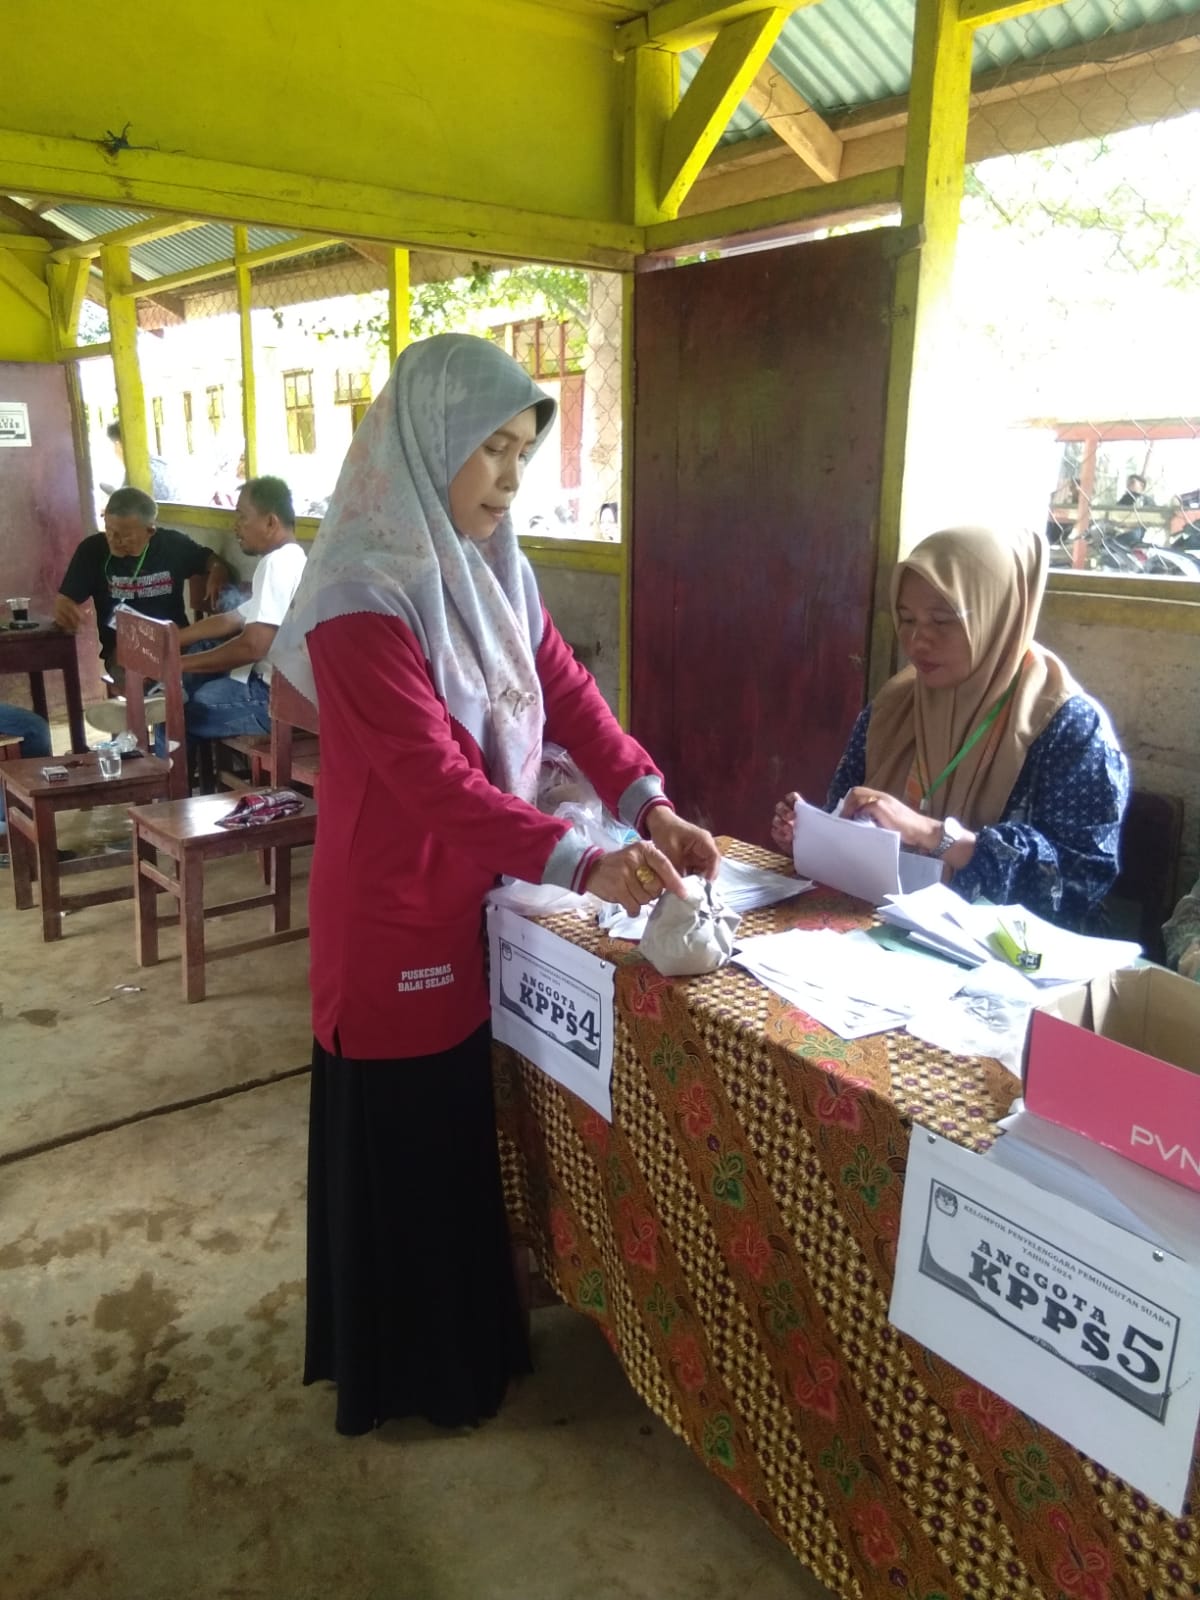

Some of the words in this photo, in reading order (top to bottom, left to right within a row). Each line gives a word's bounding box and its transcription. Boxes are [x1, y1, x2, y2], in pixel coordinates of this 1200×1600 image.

[398, 980, 424, 992] BALAI
[425, 973, 455, 989] SELASA
[401, 963, 452, 981] PUSKESMAS
[522, 972, 576, 1011] ANGGOTA
[963, 1204, 1006, 1233] KELOMPOK
[1007, 1228, 1077, 1272] PENYELENGGARA
[1077, 1268, 1139, 1309] PEMUNGUTAN
[1140, 1305, 1171, 1328] SUARA
[1022, 1247, 1051, 1268] TAHUN
[1052, 1264, 1073, 1281] 2024
[977, 1240, 1107, 1326] ANGGOTA
